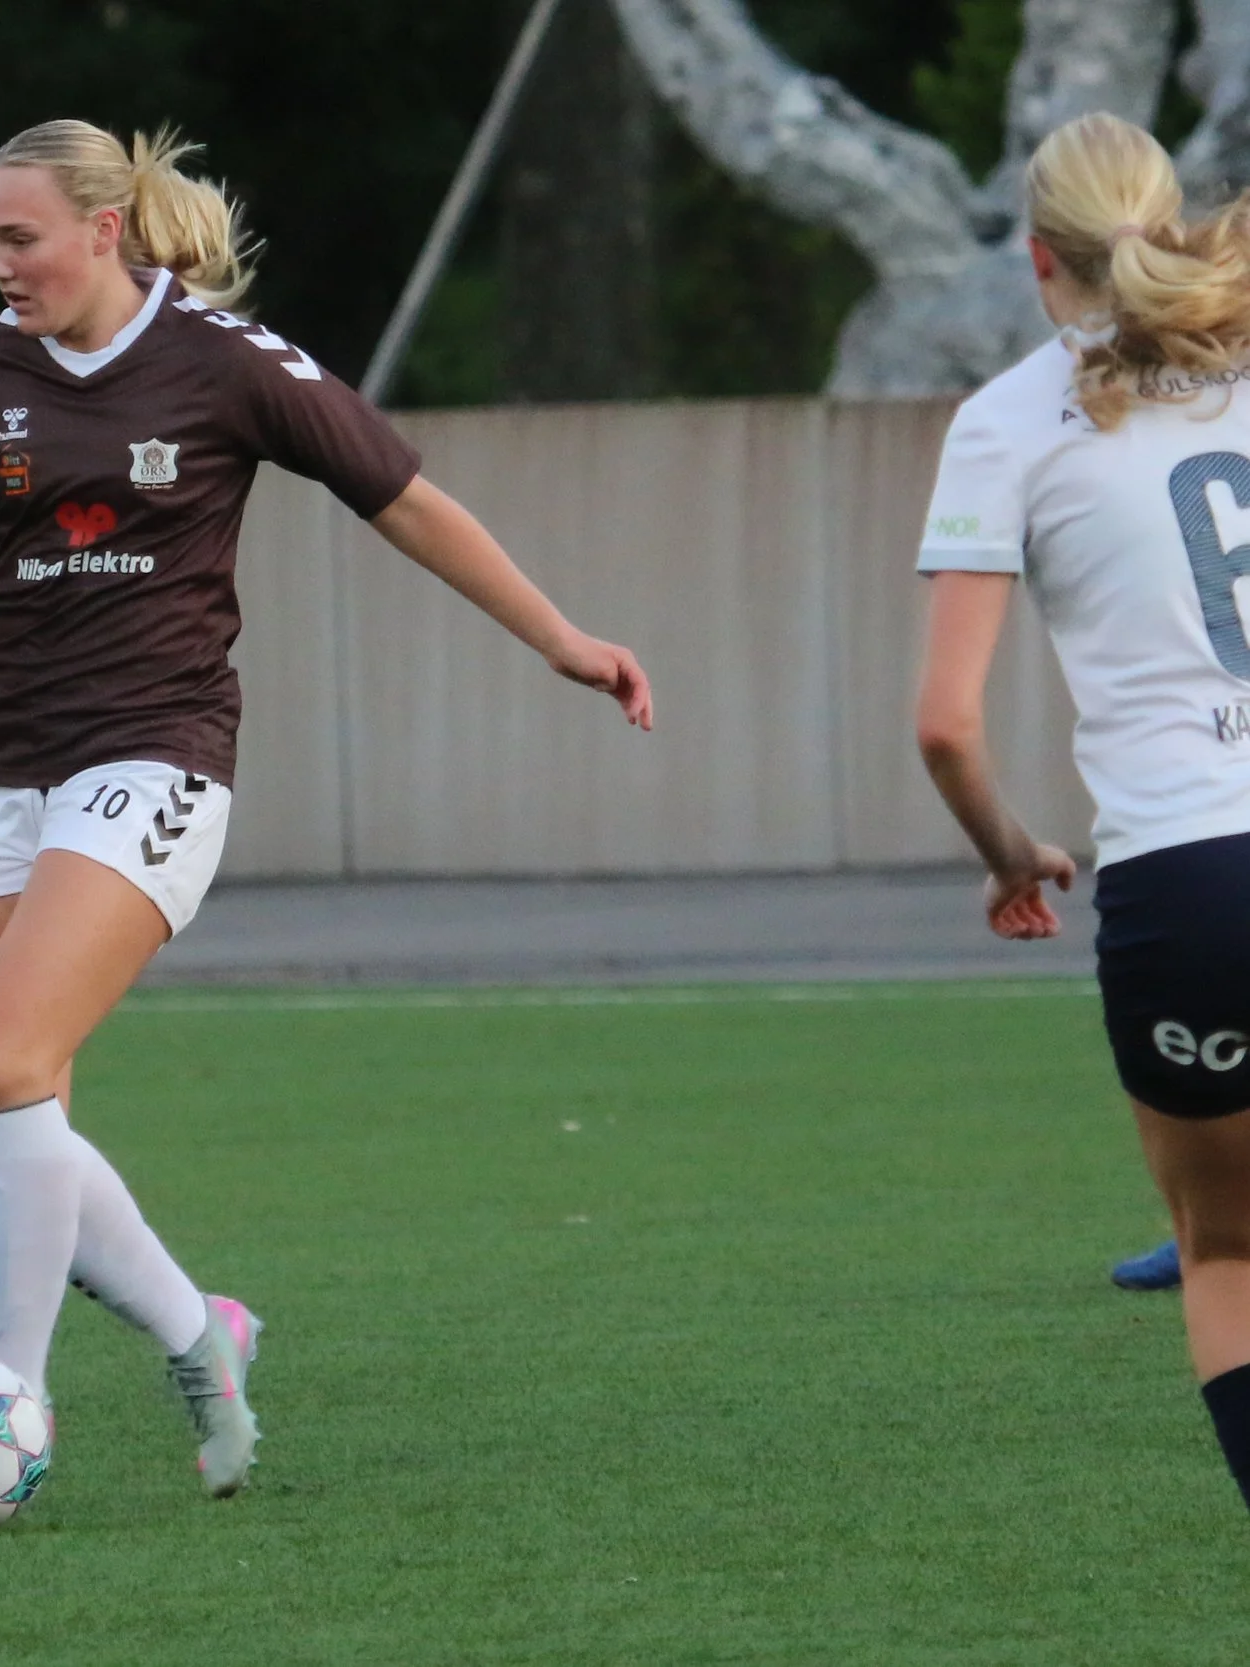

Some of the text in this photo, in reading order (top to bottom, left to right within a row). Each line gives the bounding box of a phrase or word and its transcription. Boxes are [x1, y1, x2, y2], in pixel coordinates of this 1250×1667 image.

[140, 466, 167, 476] ØRN
[67, 550, 155, 575] Elektro
[1169, 450, 1250, 680] 6
[80, 783, 131, 821] 10
